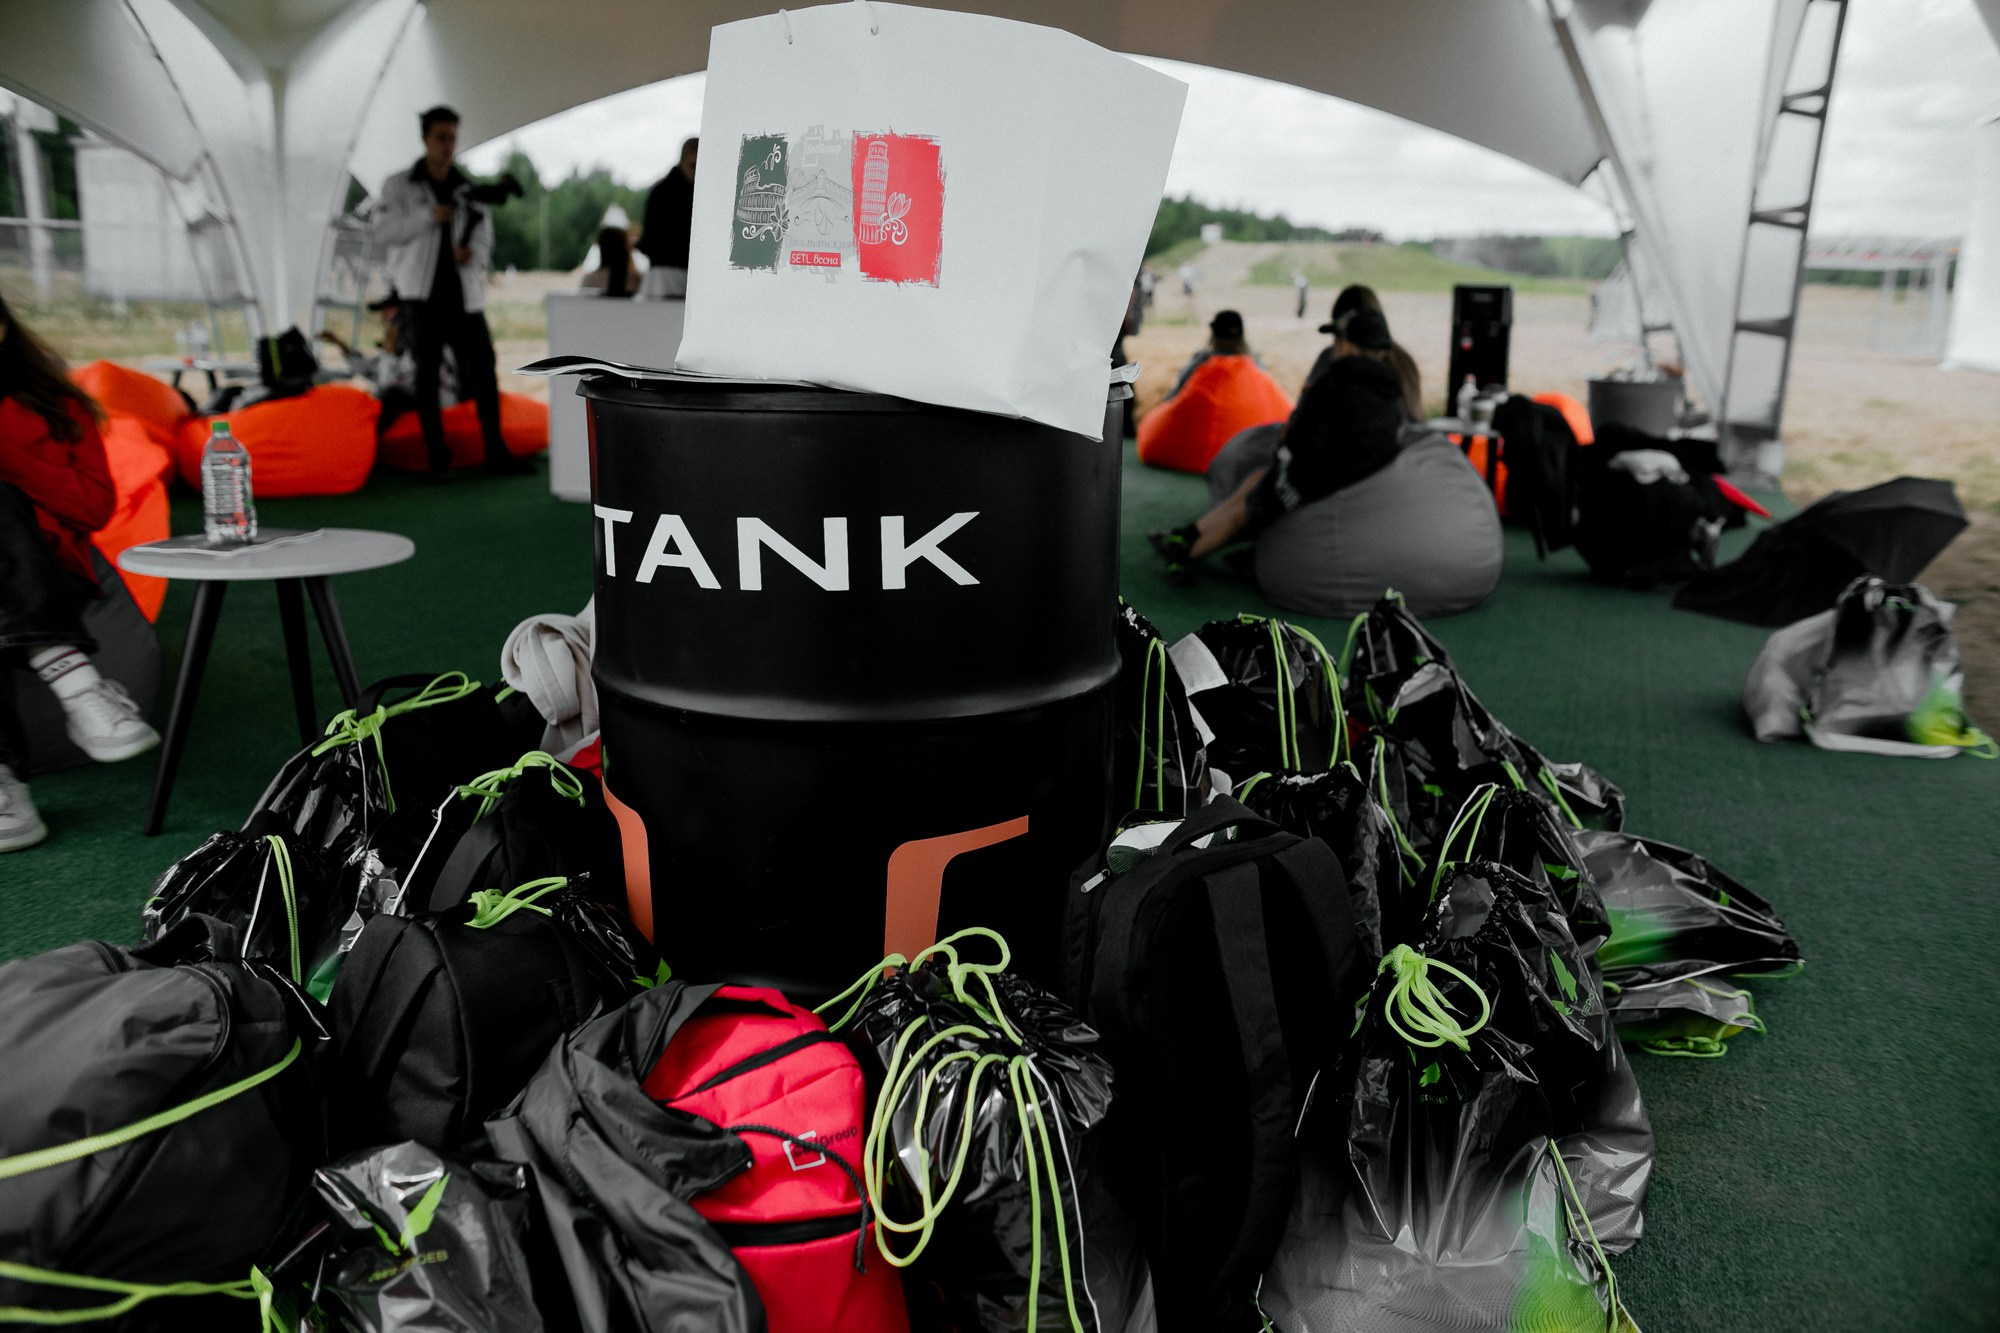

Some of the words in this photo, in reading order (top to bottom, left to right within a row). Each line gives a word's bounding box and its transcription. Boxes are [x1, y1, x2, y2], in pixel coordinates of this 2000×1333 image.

[791, 253, 811, 264] SETL
[813, 254, 838, 265] весна
[594, 504, 981, 592] TANK
